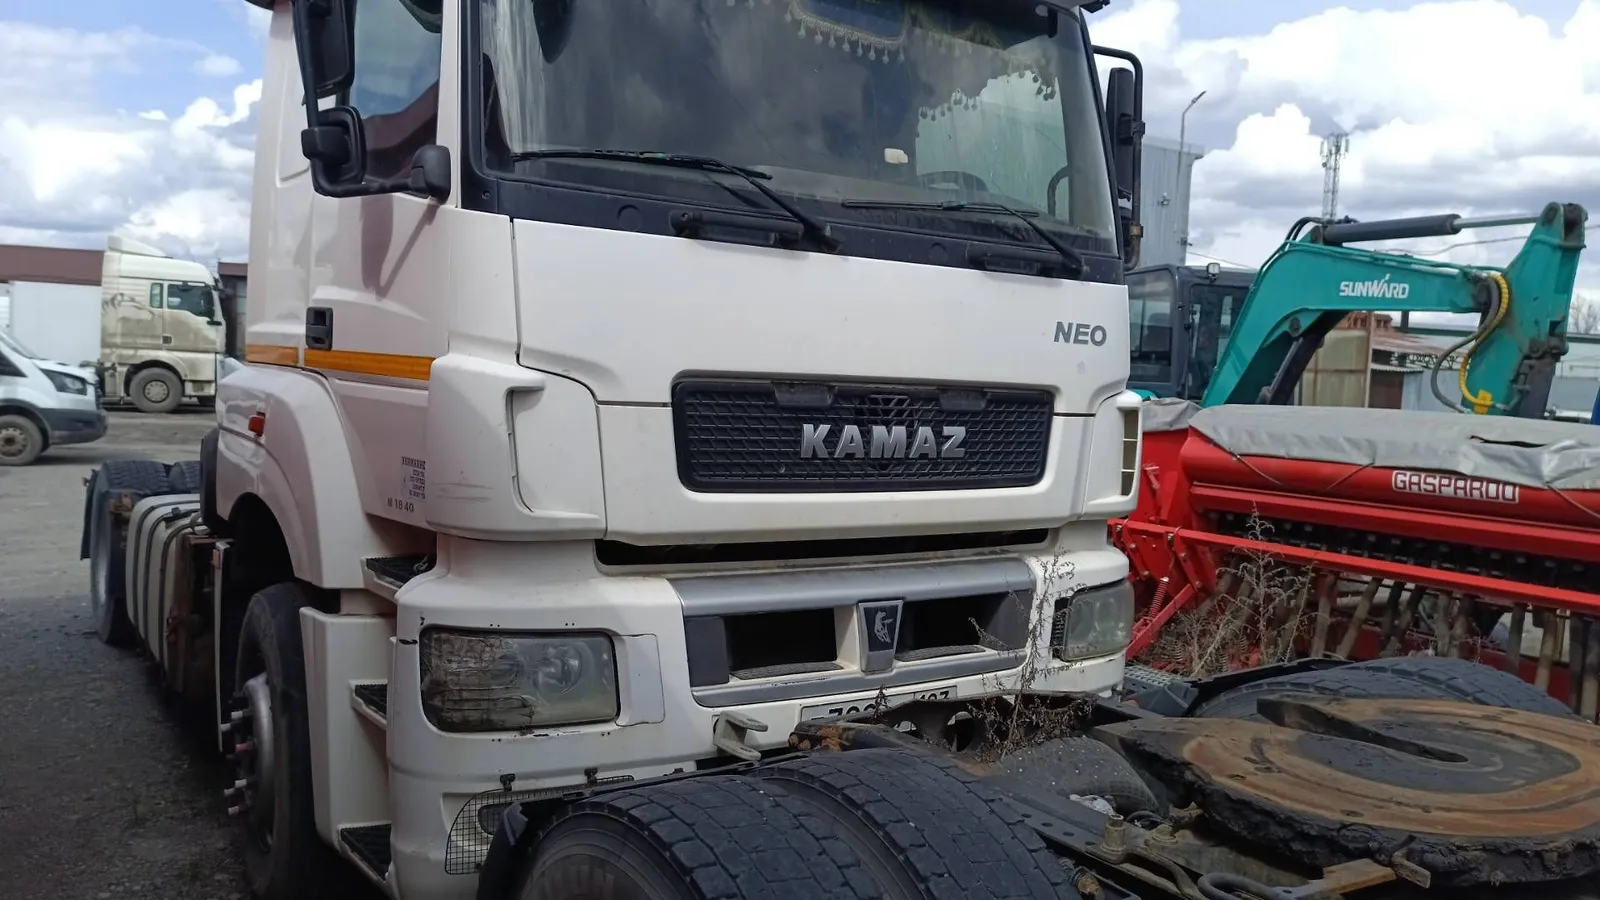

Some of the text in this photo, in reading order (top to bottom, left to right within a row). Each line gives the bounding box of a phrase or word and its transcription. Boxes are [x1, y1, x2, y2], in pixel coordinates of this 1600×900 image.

[1339, 273, 1410, 299] SUNWARD
[1053, 321, 1107, 347] NEO
[800, 423, 967, 459] KAMAZ
[1394, 471, 1518, 502] GASPARDO
